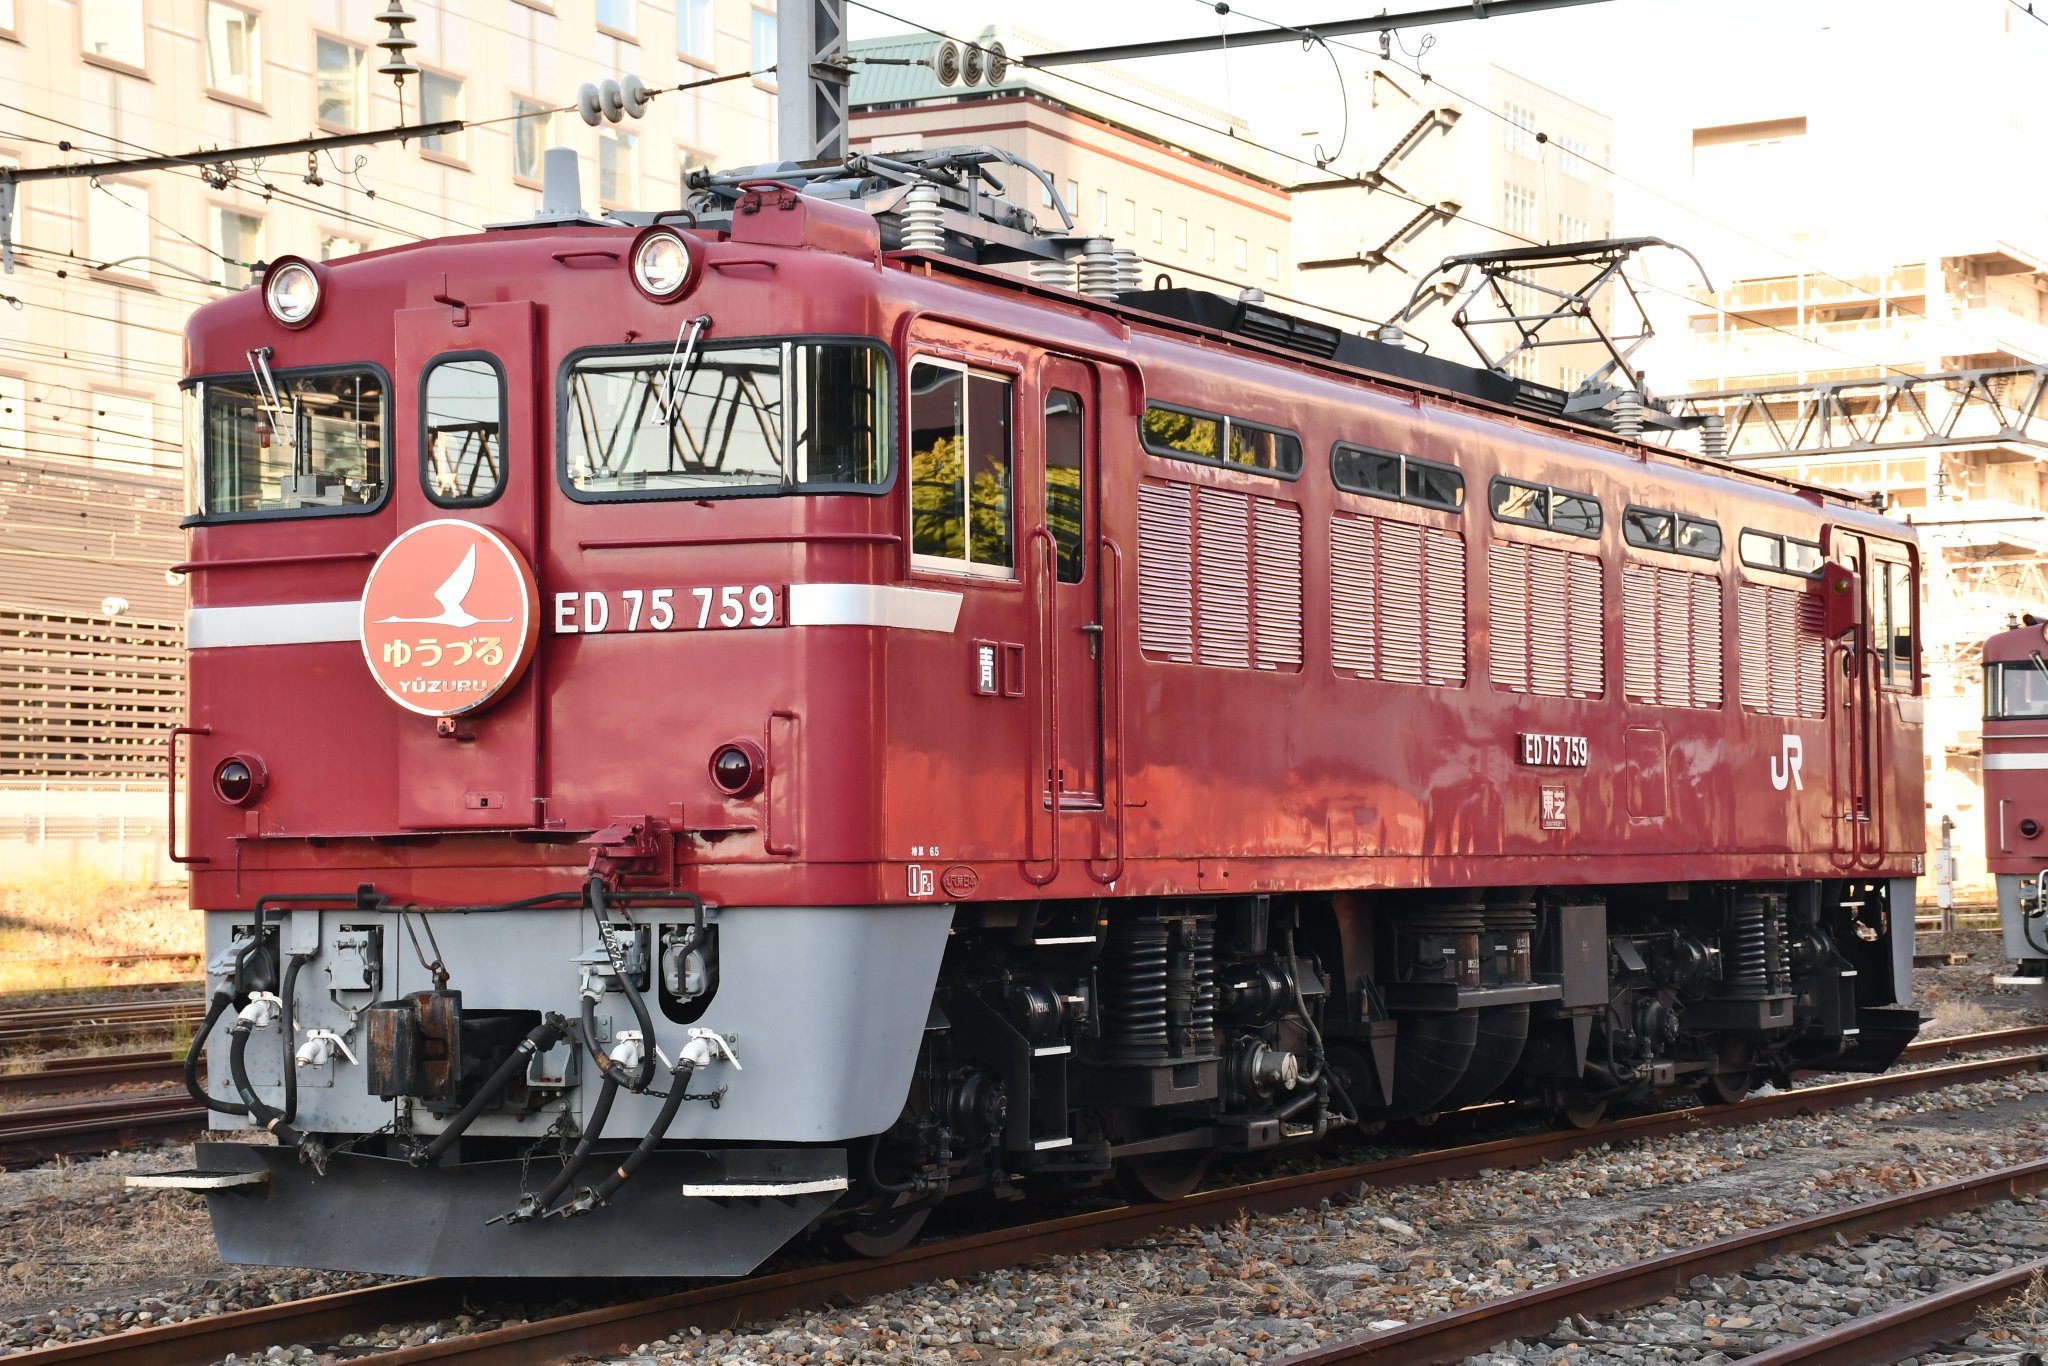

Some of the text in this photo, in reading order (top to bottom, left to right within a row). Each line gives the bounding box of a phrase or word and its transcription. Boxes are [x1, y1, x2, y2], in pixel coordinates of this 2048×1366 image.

[555, 585, 775, 634] ED 75 759
[383, 636, 505, 668] ゆうづる
[979, 646, 994, 688] 青
[1525, 733, 1588, 767] ED 75 759
[1770, 734, 1804, 791] JR
